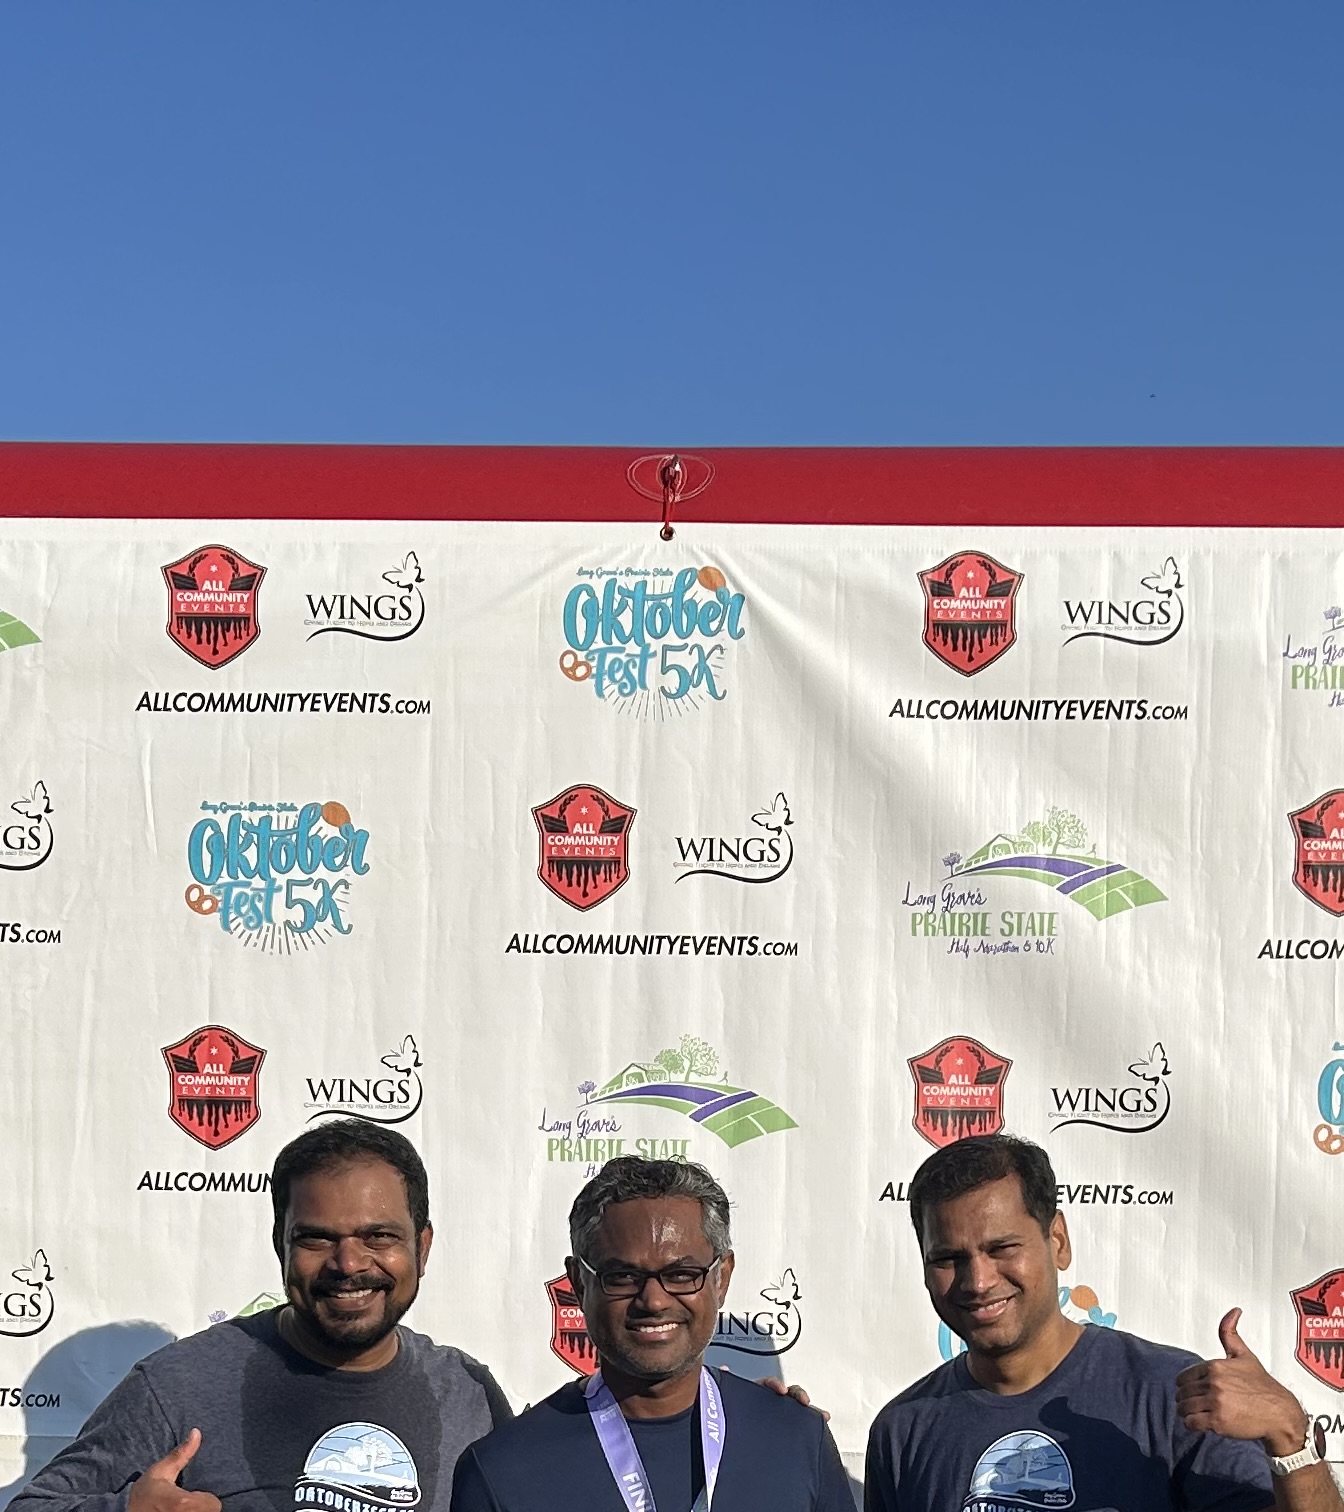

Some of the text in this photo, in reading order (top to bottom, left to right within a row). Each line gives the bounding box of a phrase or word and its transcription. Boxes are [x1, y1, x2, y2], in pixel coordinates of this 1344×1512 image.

[202, 580, 225, 591] ALL
[958, 586, 982, 598] ALL
[176, 592, 250, 603] COMMUNITY
[933, 599, 1007, 610] COMMUNITY
[180, 603, 246, 612] EVENTS
[306, 594, 412, 621] WINGS
[563, 567, 746, 651] Oktober
[936, 609, 1003, 619] EVENTS
[1063, 599, 1171, 626] WINGS
[585, 643, 728, 700] Fest 5K
[135, 692, 431, 714] ALLCOMMUNITYEVENTS.COM
[887, 698, 1189, 722] ALLCOMMUNITYEVENTS.COM
[572, 822, 596, 833] ALL
[188, 802, 370, 886] Oktober
[547, 834, 620, 845] COMMUNITY
[551, 845, 616, 855] EVENTS
[675, 836, 781, 863] WINGS
[210, 877, 353, 935] Fest 5K
[911, 911, 1059, 937] PRAIRIE STATE
[504, 933, 799, 957] ALLCOMMUNITYEVENTS.COM
[202, 1062, 226, 1073] ALL
[177, 1074, 251, 1085] COMMUNITY
[948, 1073, 971, 1084] ALL
[182, 1085, 247, 1094] EVENTS
[306, 1078, 410, 1104] WINGS
[923, 1085, 996, 1096] COMMUNITY
[926, 1096, 992, 1105] EVENTS
[1050, 1086, 1158, 1113] WINGS
[718, 1311, 790, 1336] INGS
[707, 1421, 720, 1444] All
